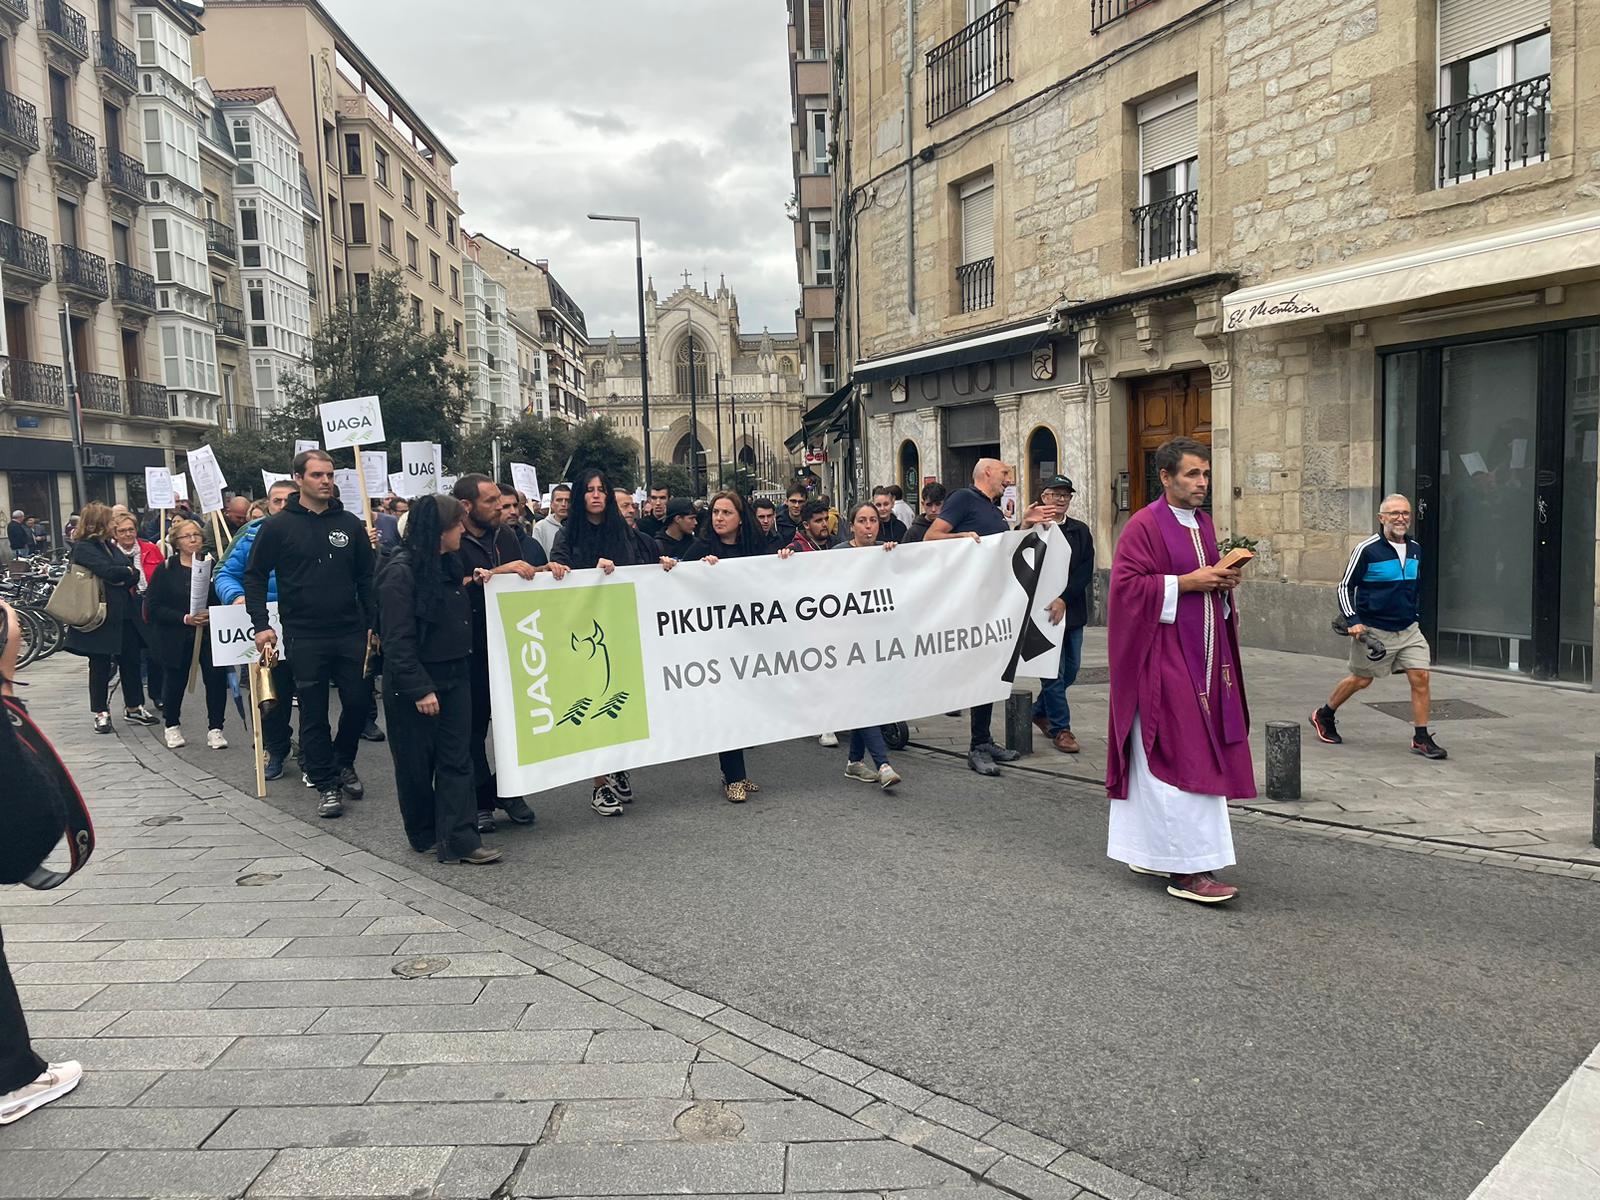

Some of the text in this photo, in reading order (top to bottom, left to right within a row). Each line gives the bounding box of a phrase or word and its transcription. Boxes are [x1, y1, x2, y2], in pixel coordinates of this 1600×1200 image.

[1227, 309, 1246, 329] El
[326, 415, 372, 433] UAGA
[408, 461, 435, 476] UAG
[656, 587, 895, 637] PIKUTARA GOAZ!!!
[217, 626, 257, 644] UAG
[662, 617, 1013, 692] NOS VAMOS A LA MIERDA!!!
[515, 608, 554, 736] UAGA
